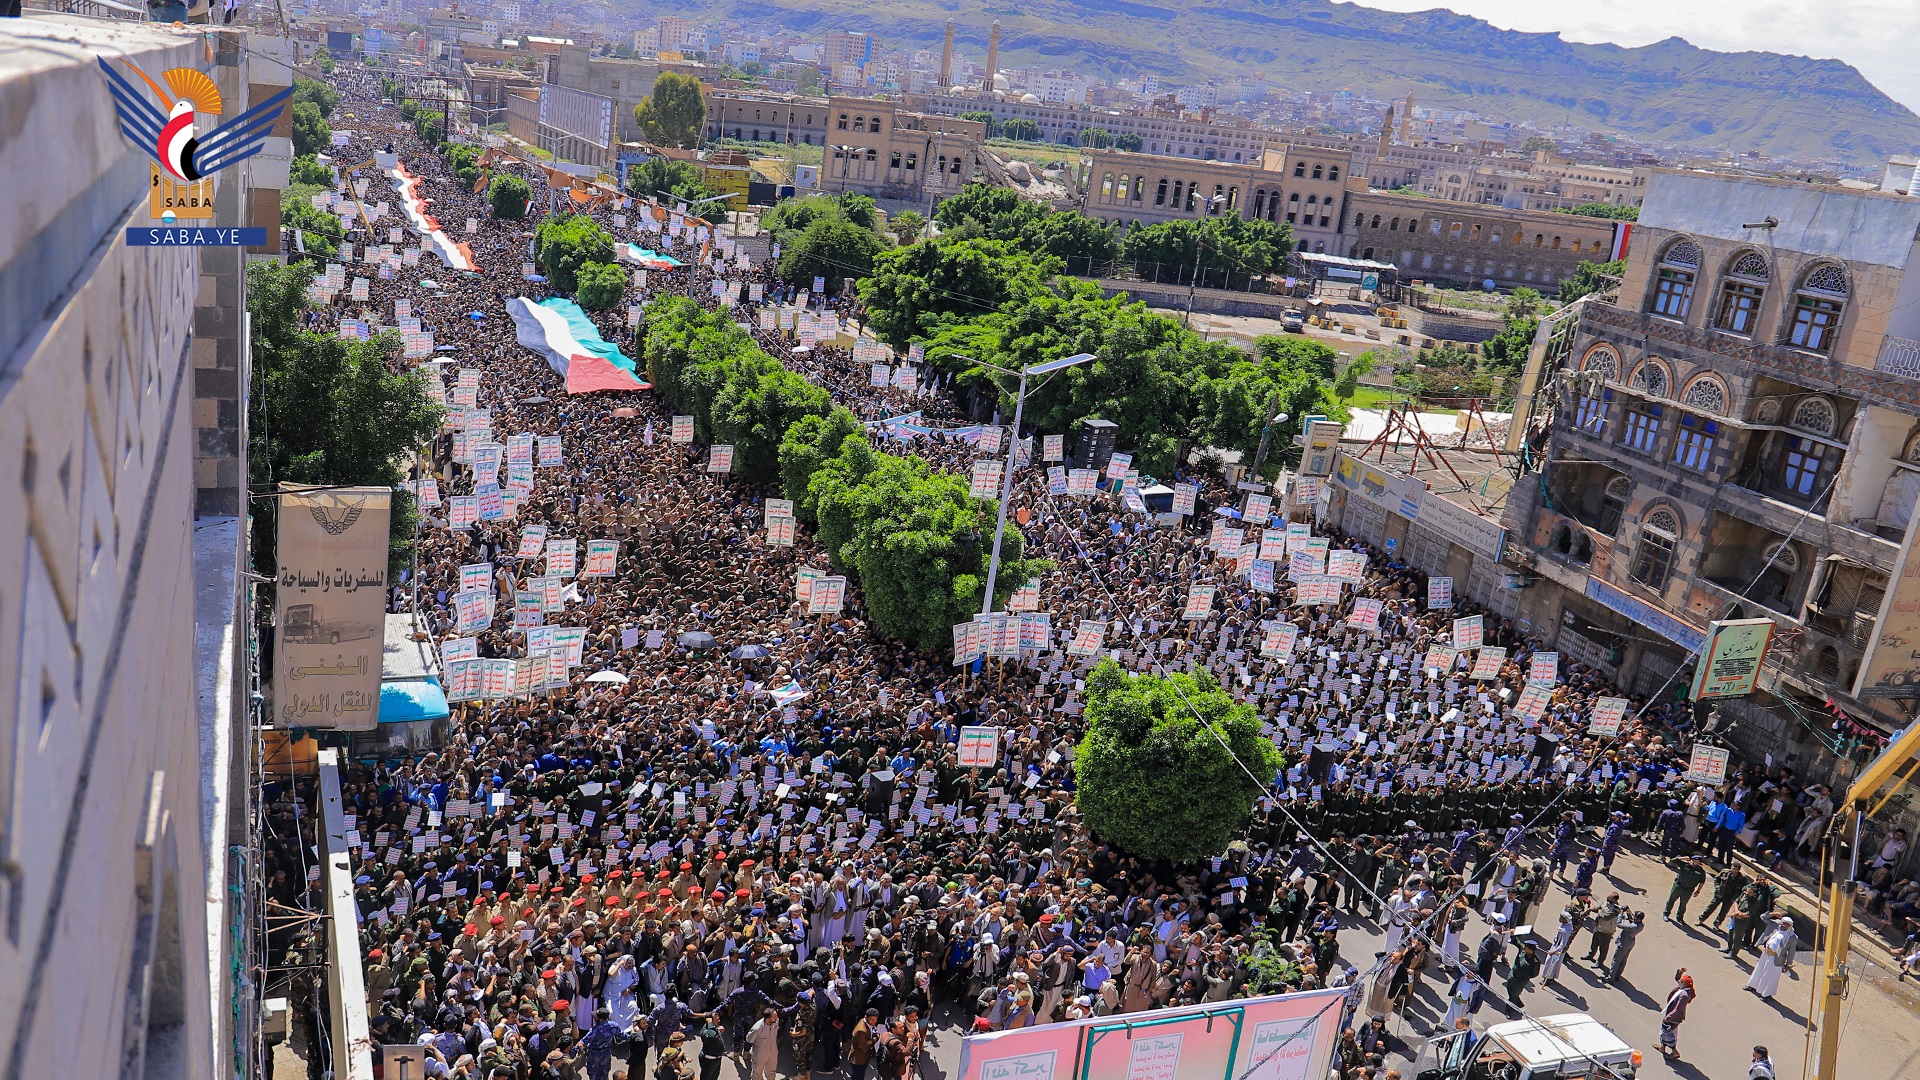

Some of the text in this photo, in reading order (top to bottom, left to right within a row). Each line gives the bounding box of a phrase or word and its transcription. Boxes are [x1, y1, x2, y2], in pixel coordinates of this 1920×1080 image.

[281, 566, 385, 593] للسفريات والسياحة
[1591, 580, 1642, 621] Yemenia
[334, 690, 373, 717] للنقل
